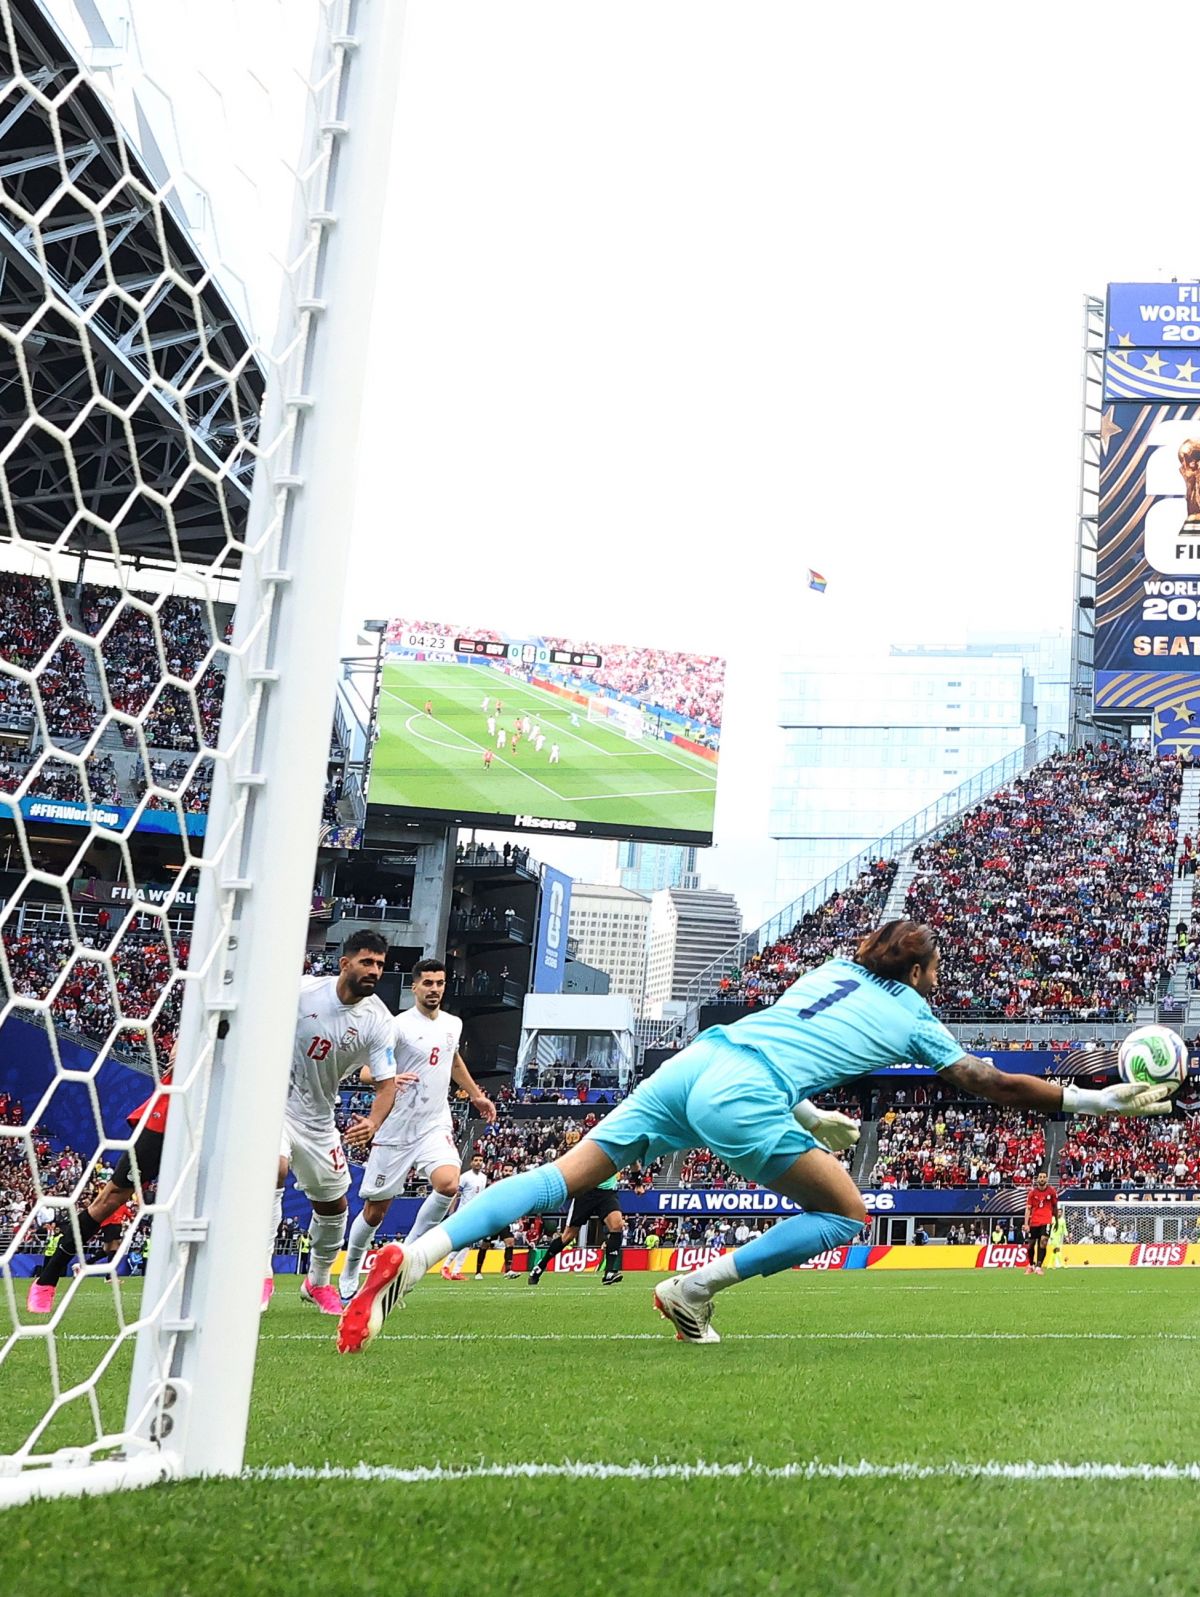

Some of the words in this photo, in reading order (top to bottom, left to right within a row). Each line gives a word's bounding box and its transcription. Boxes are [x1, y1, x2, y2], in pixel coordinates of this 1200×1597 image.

[409, 635, 446, 650] 04:23
[514, 814, 577, 832] Hisense
[149, 889, 200, 904] WORL
[797, 979, 861, 1020] 1
[306, 1036, 332, 1061] 13
[429, 1047, 440, 1067] 6
[658, 1193, 701, 1210] FIFA
[701, 1193, 778, 1210] WORLD
[863, 1193, 894, 1210] 26
[554, 1248, 598, 1272] Lay's
[983, 1243, 1028, 1268] Lay's
[1137, 1243, 1181, 1266] Lay's
